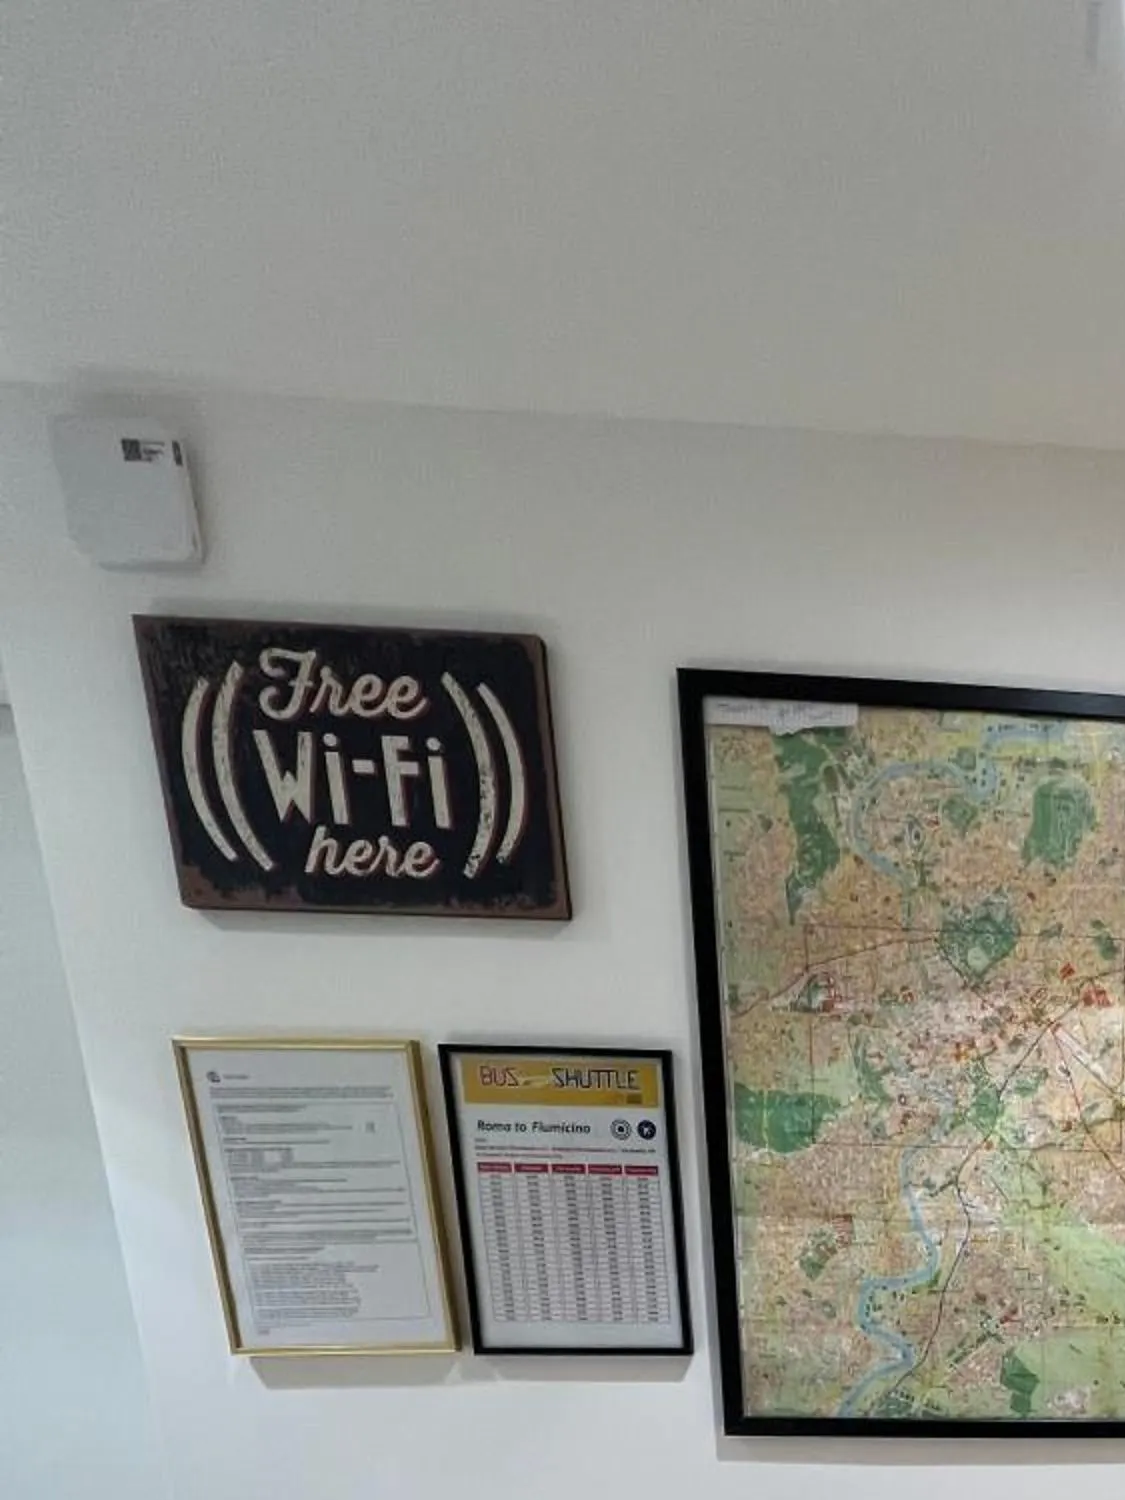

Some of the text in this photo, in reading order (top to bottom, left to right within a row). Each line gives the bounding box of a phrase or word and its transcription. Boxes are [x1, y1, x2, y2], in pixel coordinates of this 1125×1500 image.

[258, 647, 430, 720] Free
[252, 729, 451, 830] Wi-Fi
[304, 824, 440, 878] here
[479, 1065, 641, 1090] BUS SHUTTLE
[476, 1119, 512, 1133] Roma
[515, 1120, 527, 1133] to
